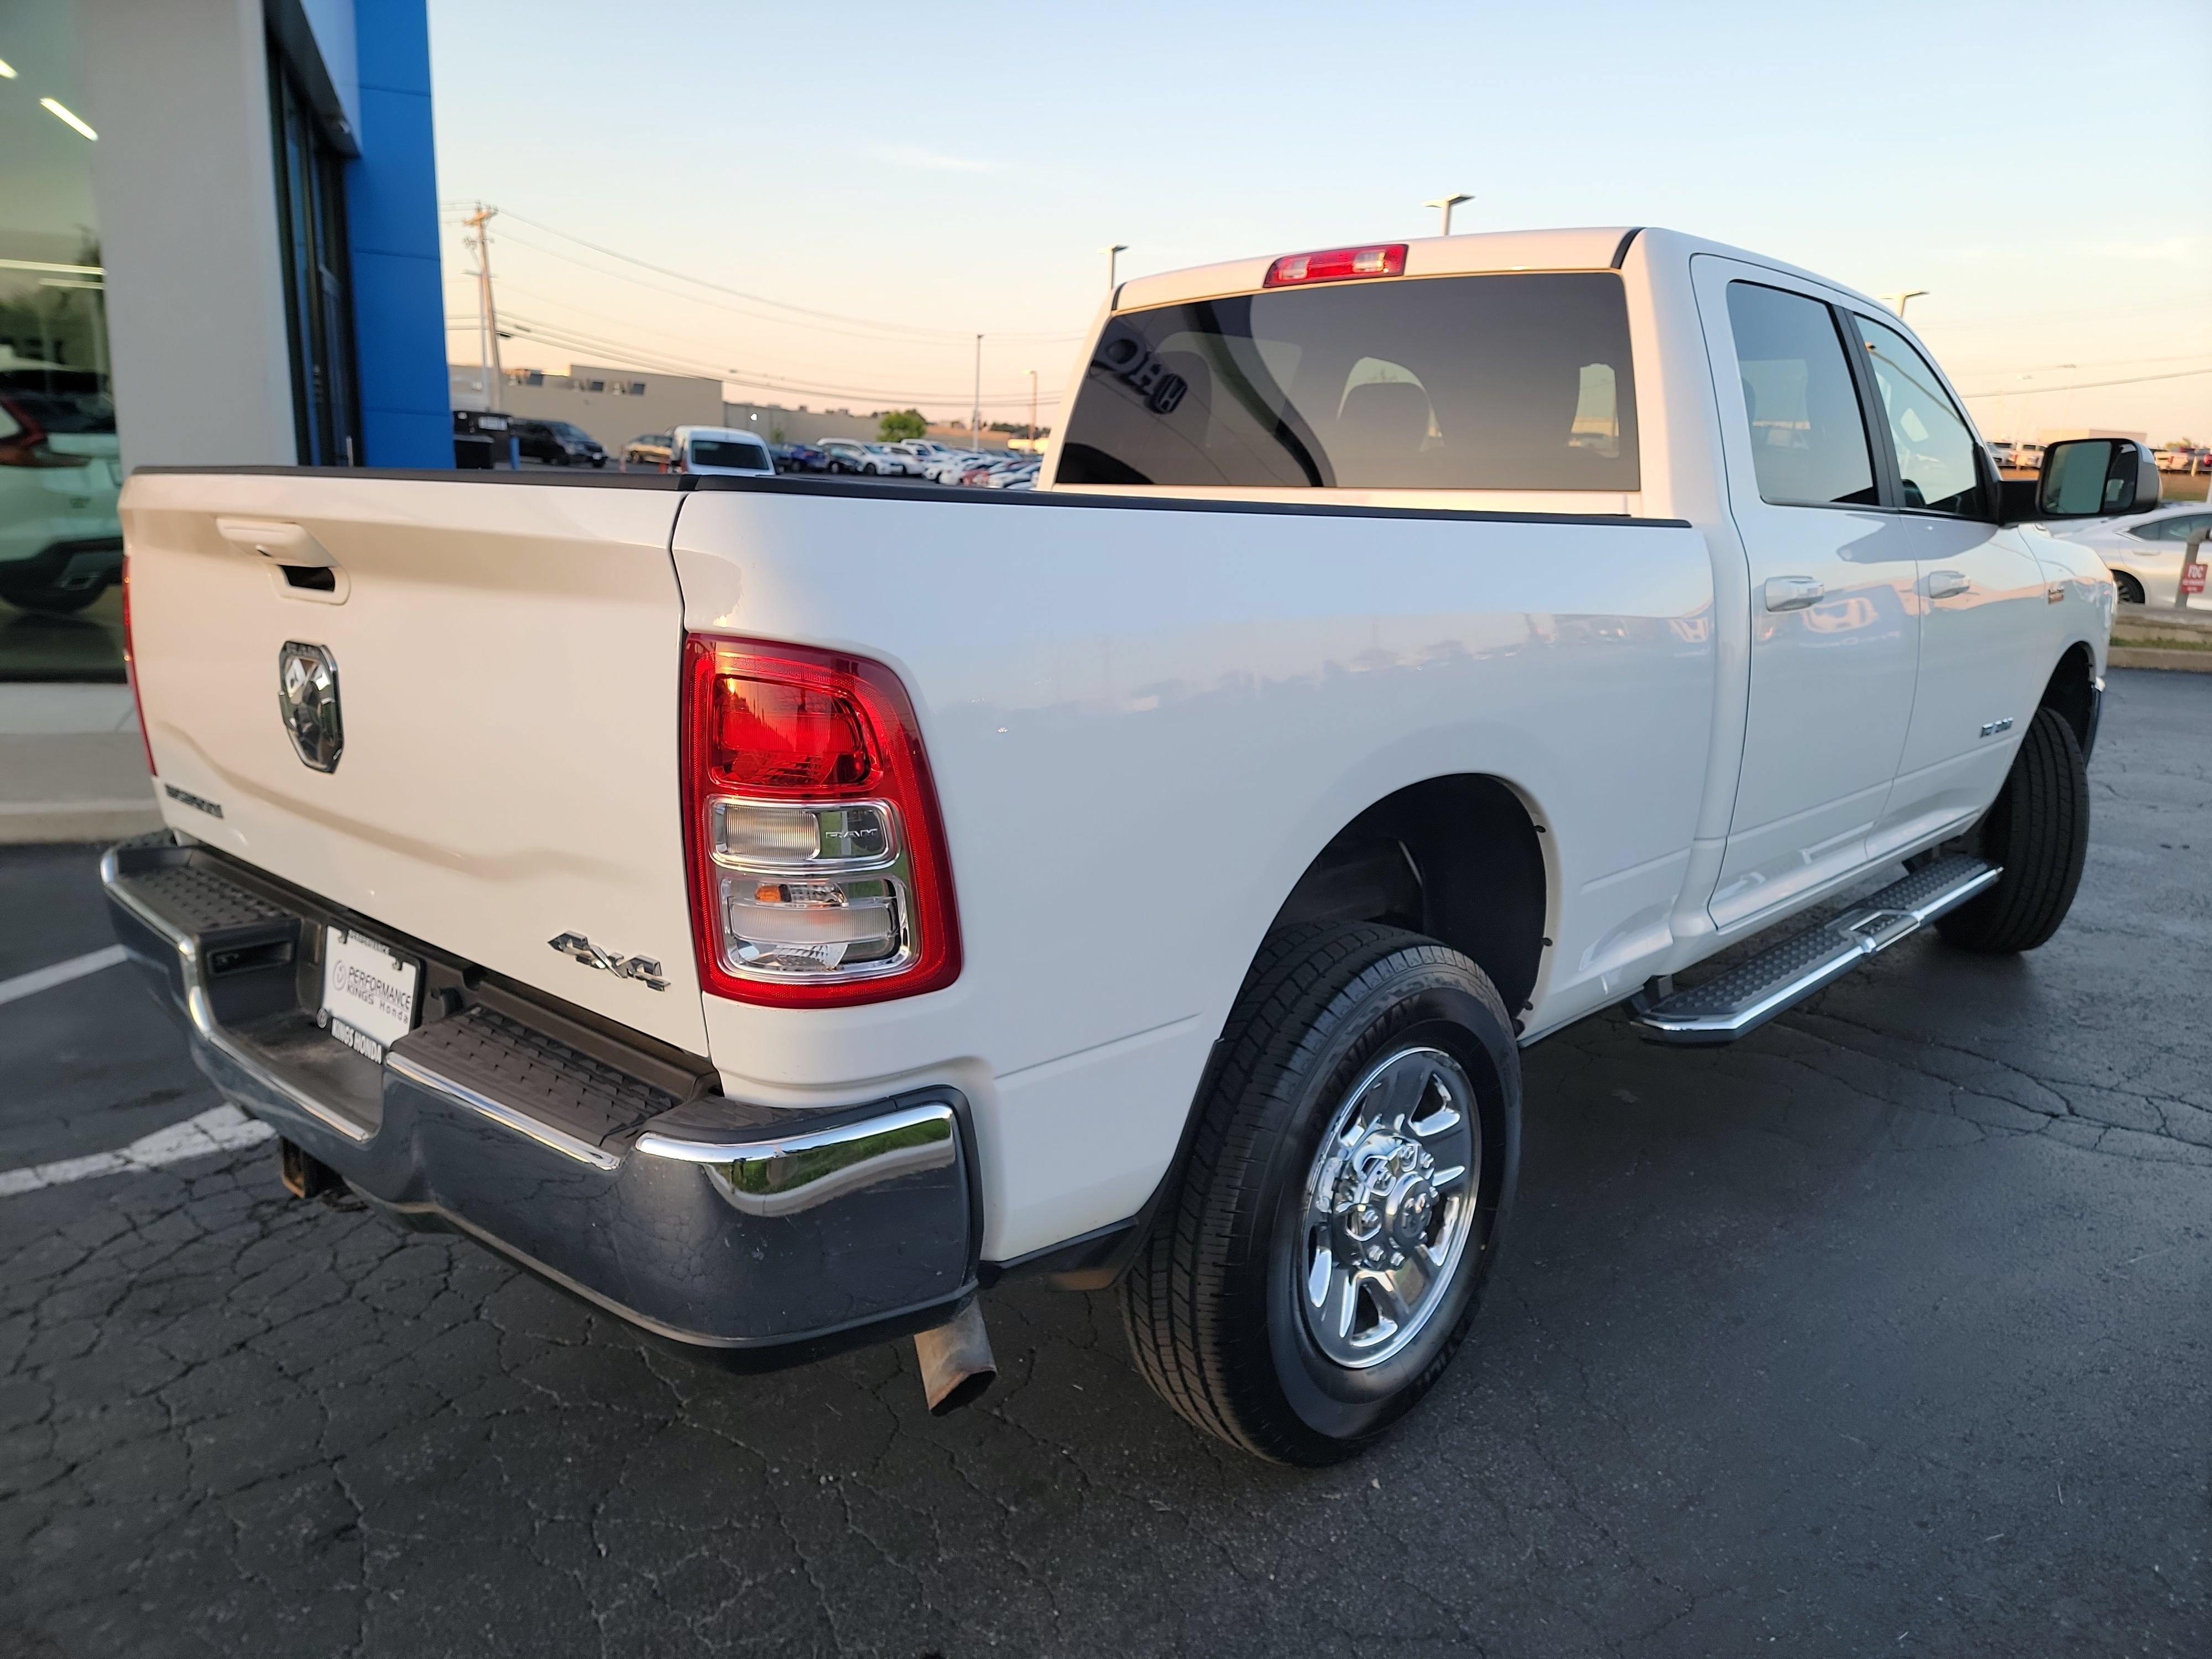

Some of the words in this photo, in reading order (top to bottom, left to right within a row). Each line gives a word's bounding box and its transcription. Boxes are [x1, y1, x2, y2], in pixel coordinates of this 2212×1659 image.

[2188, 565, 2204, 578] FDC
[825, 828, 878, 839] RAM
[346, 984, 374, 1005] KINGS
[379, 1000, 409, 1024] Honda
[348, 967, 411, 1010] PERFORMANCE
[331, 1018, 354, 1047] KINGS
[353, 1031, 382, 1065] HONDA
